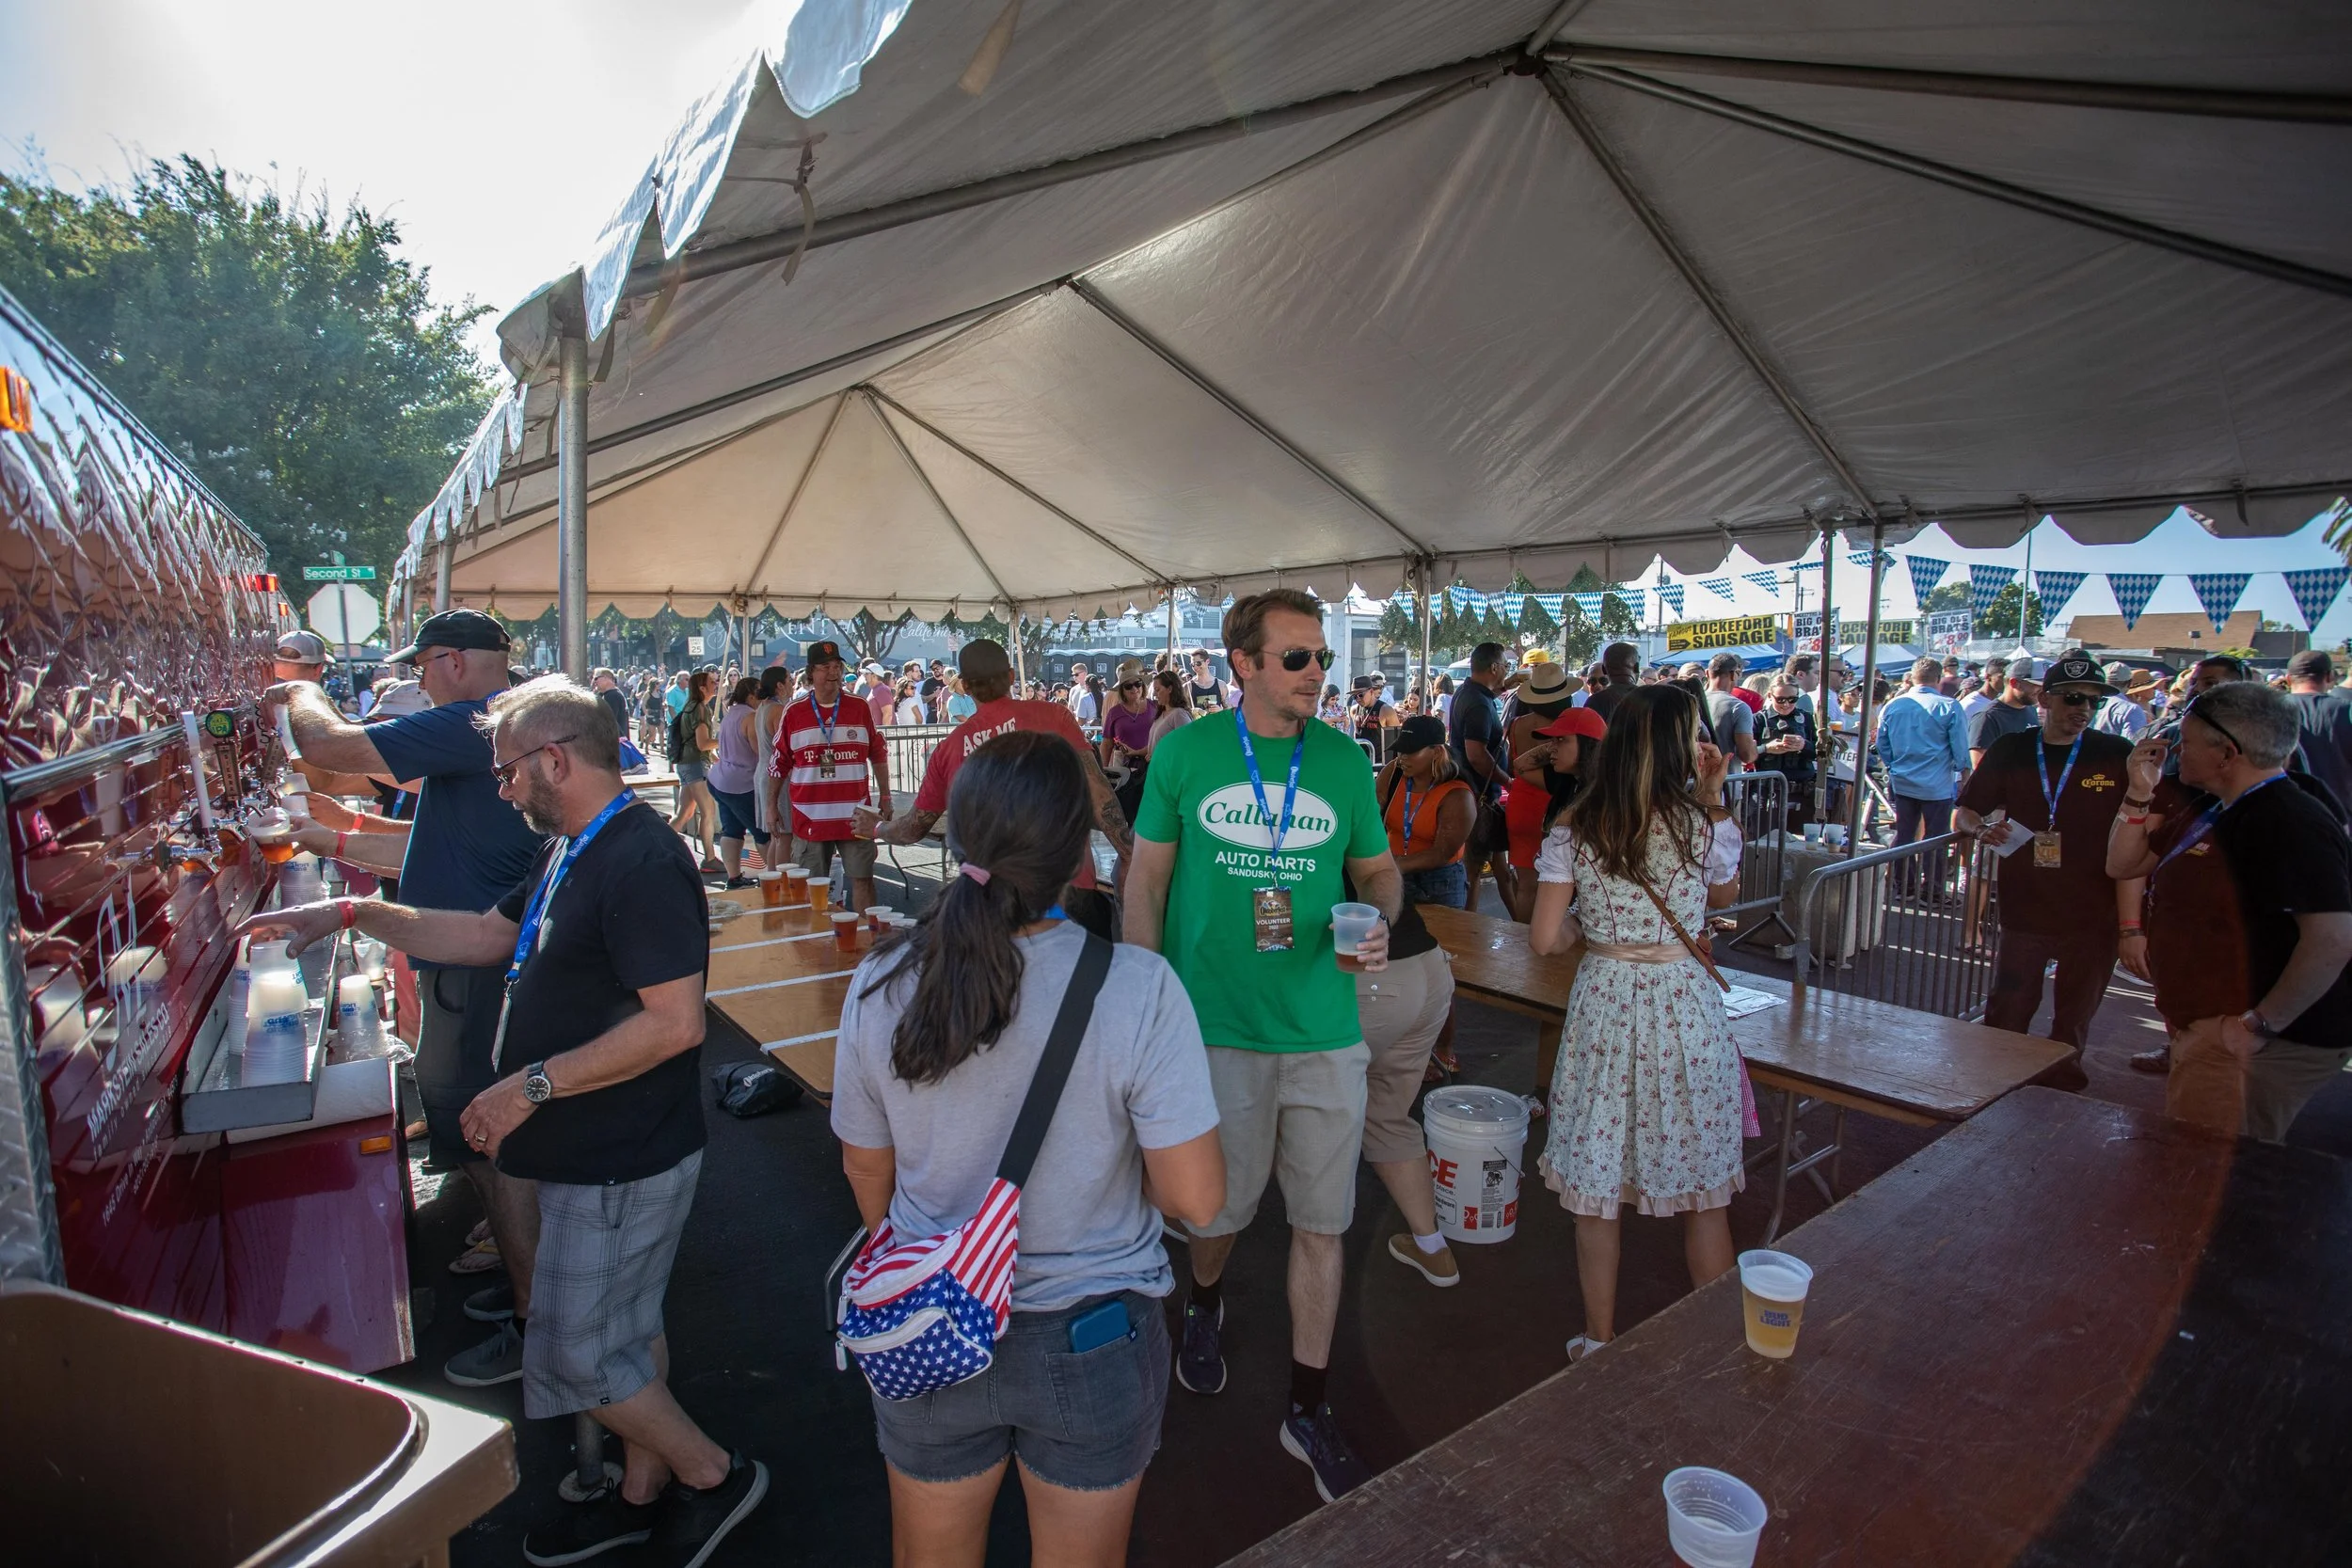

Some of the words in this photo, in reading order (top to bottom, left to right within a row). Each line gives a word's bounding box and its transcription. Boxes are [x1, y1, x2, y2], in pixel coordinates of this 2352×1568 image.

[305, 568, 347, 578] Second
[351, 568, 361, 578] St
[1692, 616, 1773, 635] LOCKEFORD
[1796, 617, 1812, 626] BIG
[1841, 621, 1910, 633] OCKFORD
[1931, 617, 1947, 626] BIG
[1794, 625, 1836, 638] BRAS
[1931, 622, 1969, 635] BRATS
[1692, 629, 1773, 649] SAUSAGE
[1839, 631, 1910, 645] SAUAGE
[691, 645, 702, 654] 25
[963, 727, 993, 757] ASK
[2081, 778, 2115, 788] Corona
[1215, 850, 1260, 868] AUTO
[1263, 853, 1316, 872] PARTS
[1279, 871, 1303, 881] OHIO
[1256, 917, 1291, 926] VOLUNTEER
[87, 1052, 135, 1141] MARKSTEIN
[120, 1079, 140, 1117] owned
[1426, 1148, 1458, 1189] CE
[1764, 1309, 1788, 1321] BUD
[1760, 1316, 1791, 1327] LIGHT
